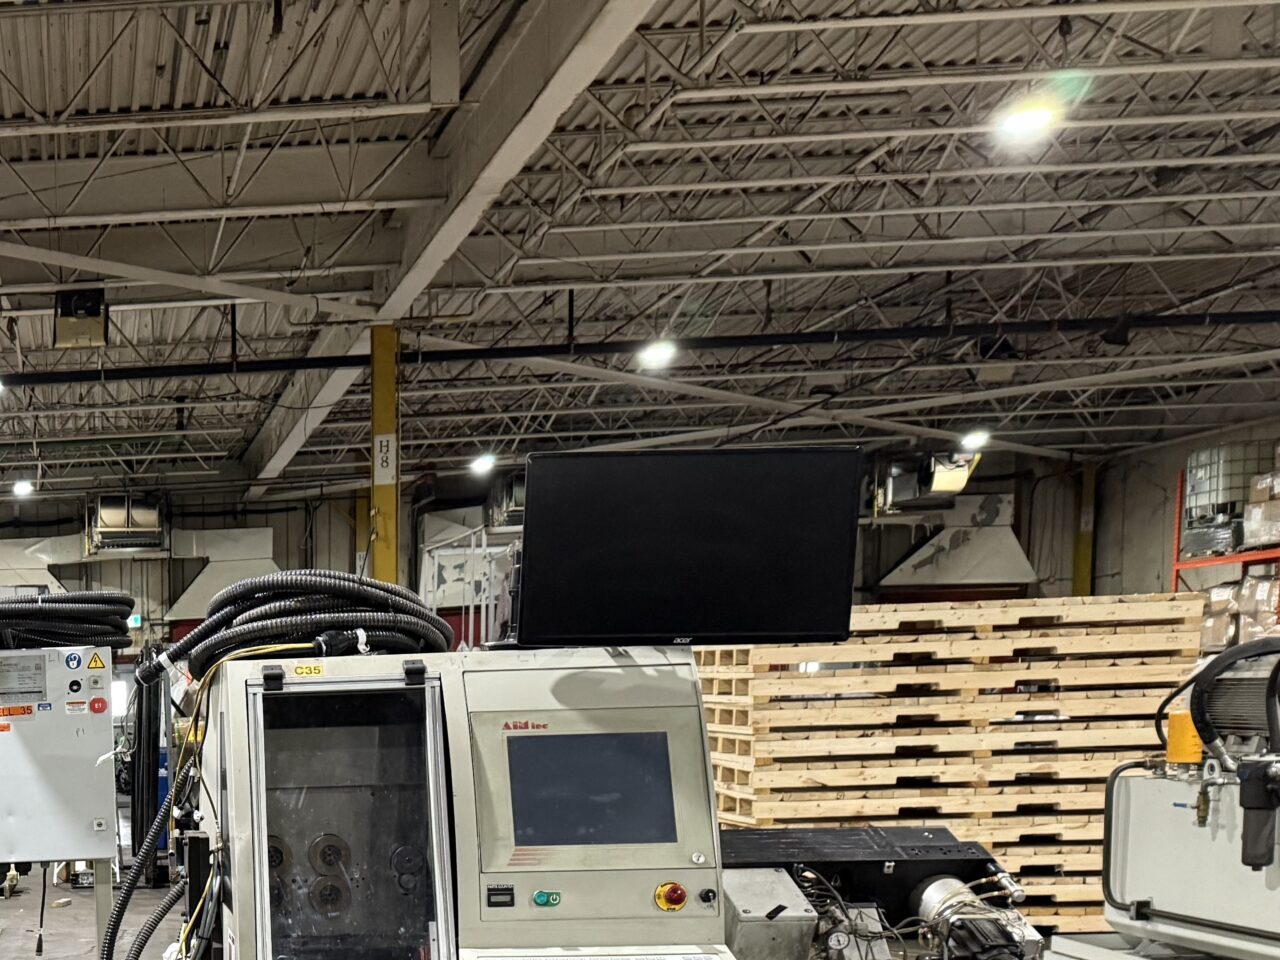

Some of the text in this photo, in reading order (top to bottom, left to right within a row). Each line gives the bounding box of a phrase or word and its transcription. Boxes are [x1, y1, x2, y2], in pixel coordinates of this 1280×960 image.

[379, 440, 390, 453] H
[381, 456, 389, 468] 8
[294, 666, 321, 675] C35
[20, 706, 32, 715] 35
[502, 720, 529, 730] AIM
